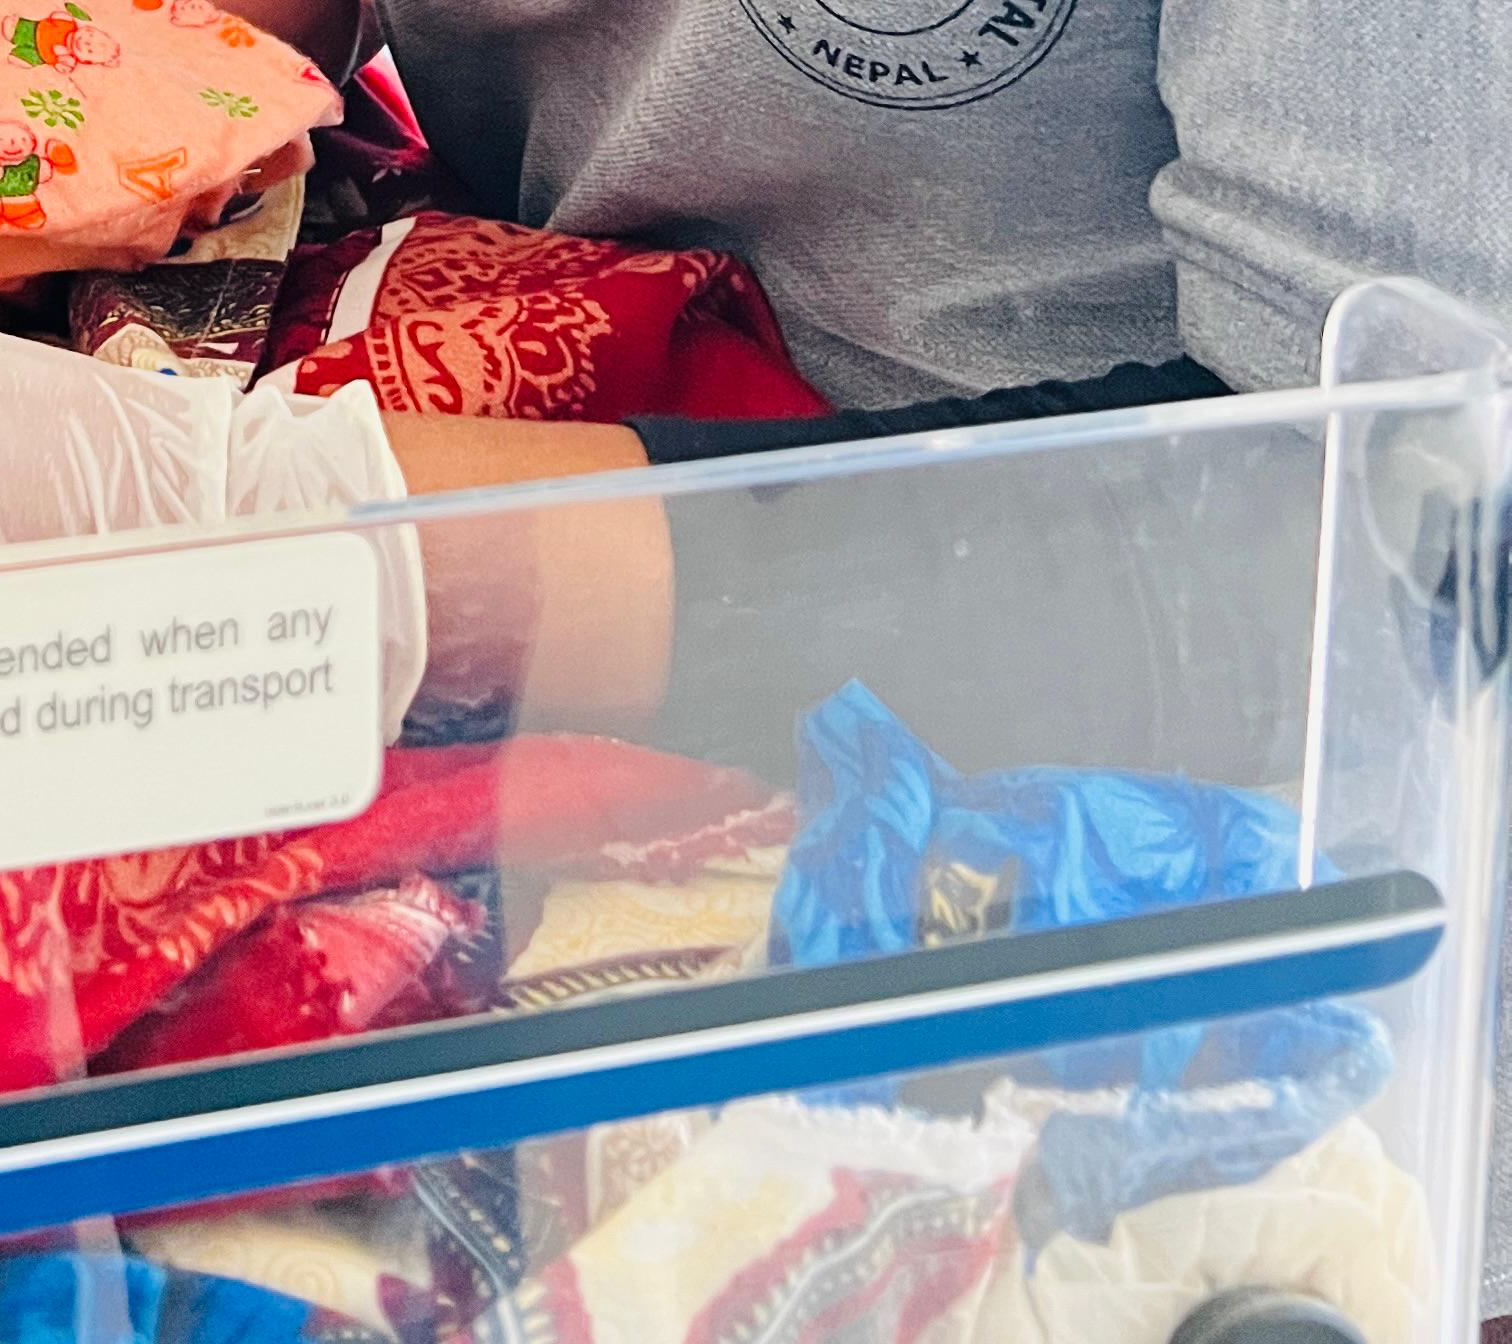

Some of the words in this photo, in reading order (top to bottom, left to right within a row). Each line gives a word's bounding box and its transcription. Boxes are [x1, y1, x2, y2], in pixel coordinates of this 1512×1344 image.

[812, 39, 948, 86] NEPAL
[139, 610, 241, 661] when
[266, 601, 334, 646] any
[36, 684, 154, 735] during
[168, 658, 334, 717] transport
